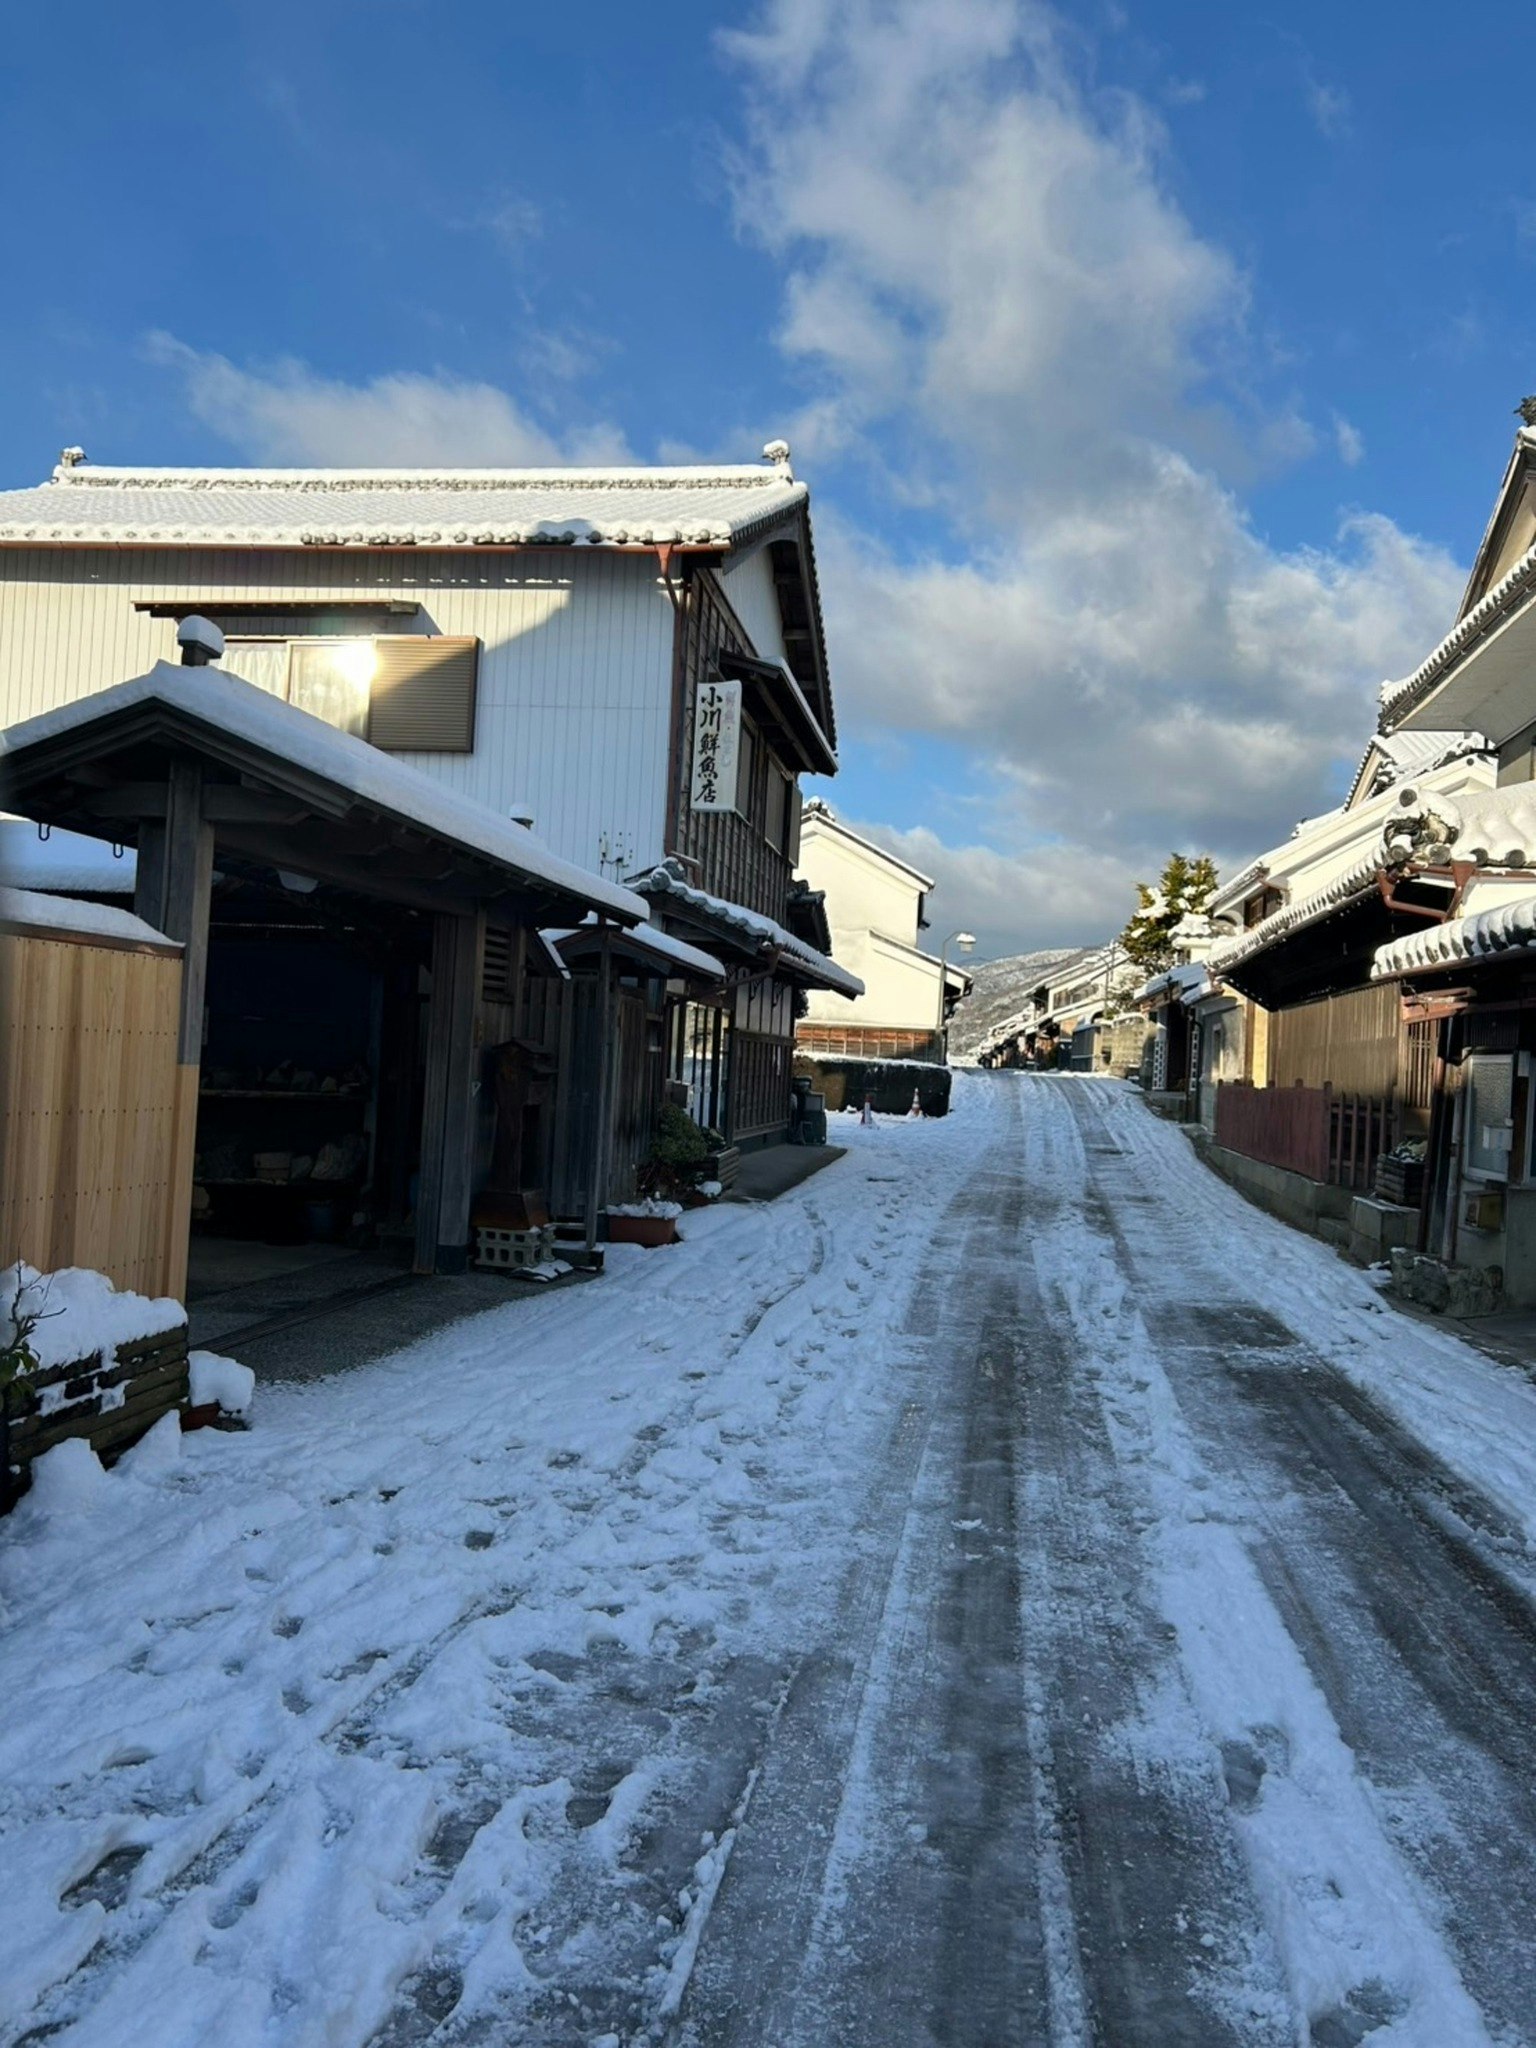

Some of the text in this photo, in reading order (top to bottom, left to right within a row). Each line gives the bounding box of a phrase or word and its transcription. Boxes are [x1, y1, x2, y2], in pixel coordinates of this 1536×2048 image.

[694, 686, 723, 804] 小川鮮魚店
